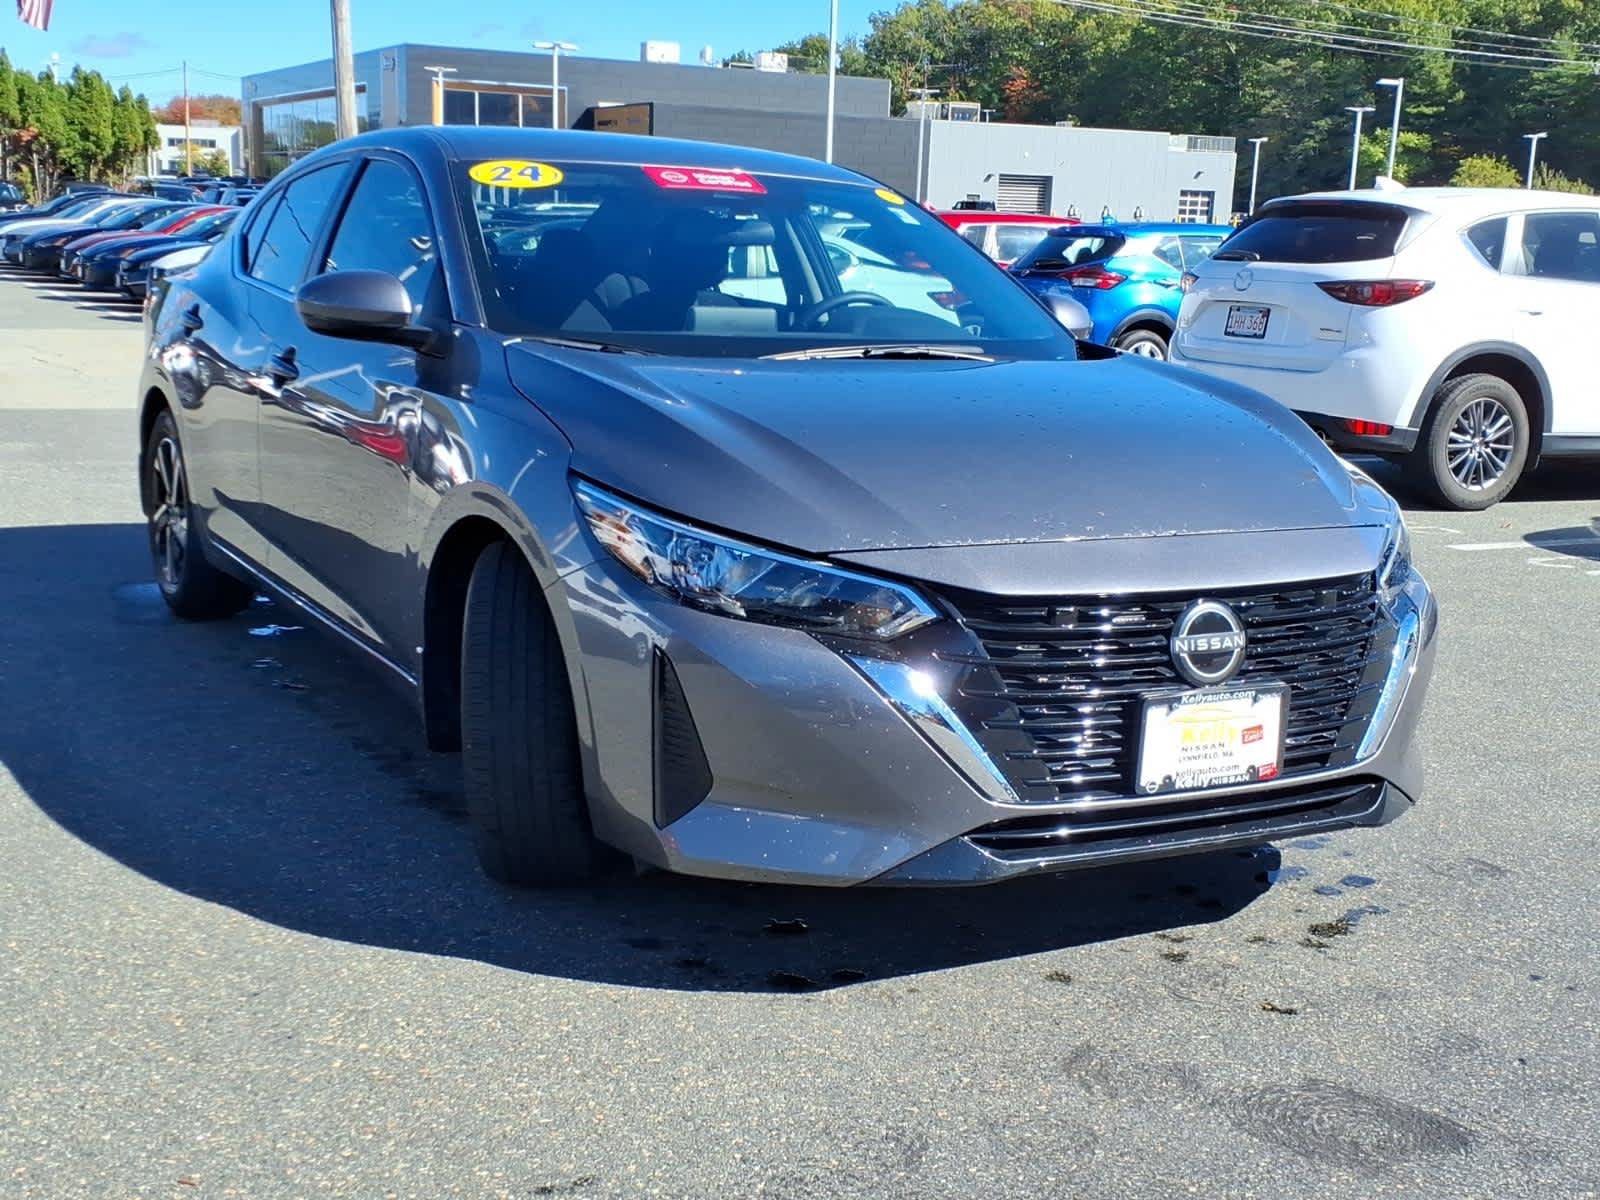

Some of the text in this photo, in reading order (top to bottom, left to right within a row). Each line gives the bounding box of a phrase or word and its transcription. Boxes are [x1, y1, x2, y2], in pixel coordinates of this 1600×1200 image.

[490, 166, 542, 181] 24
[1175, 634, 1244, 652] NISSAN
[1181, 741, 1225, 752] NISSAN
[1175, 773, 1250, 789] Kelly NISSAN
